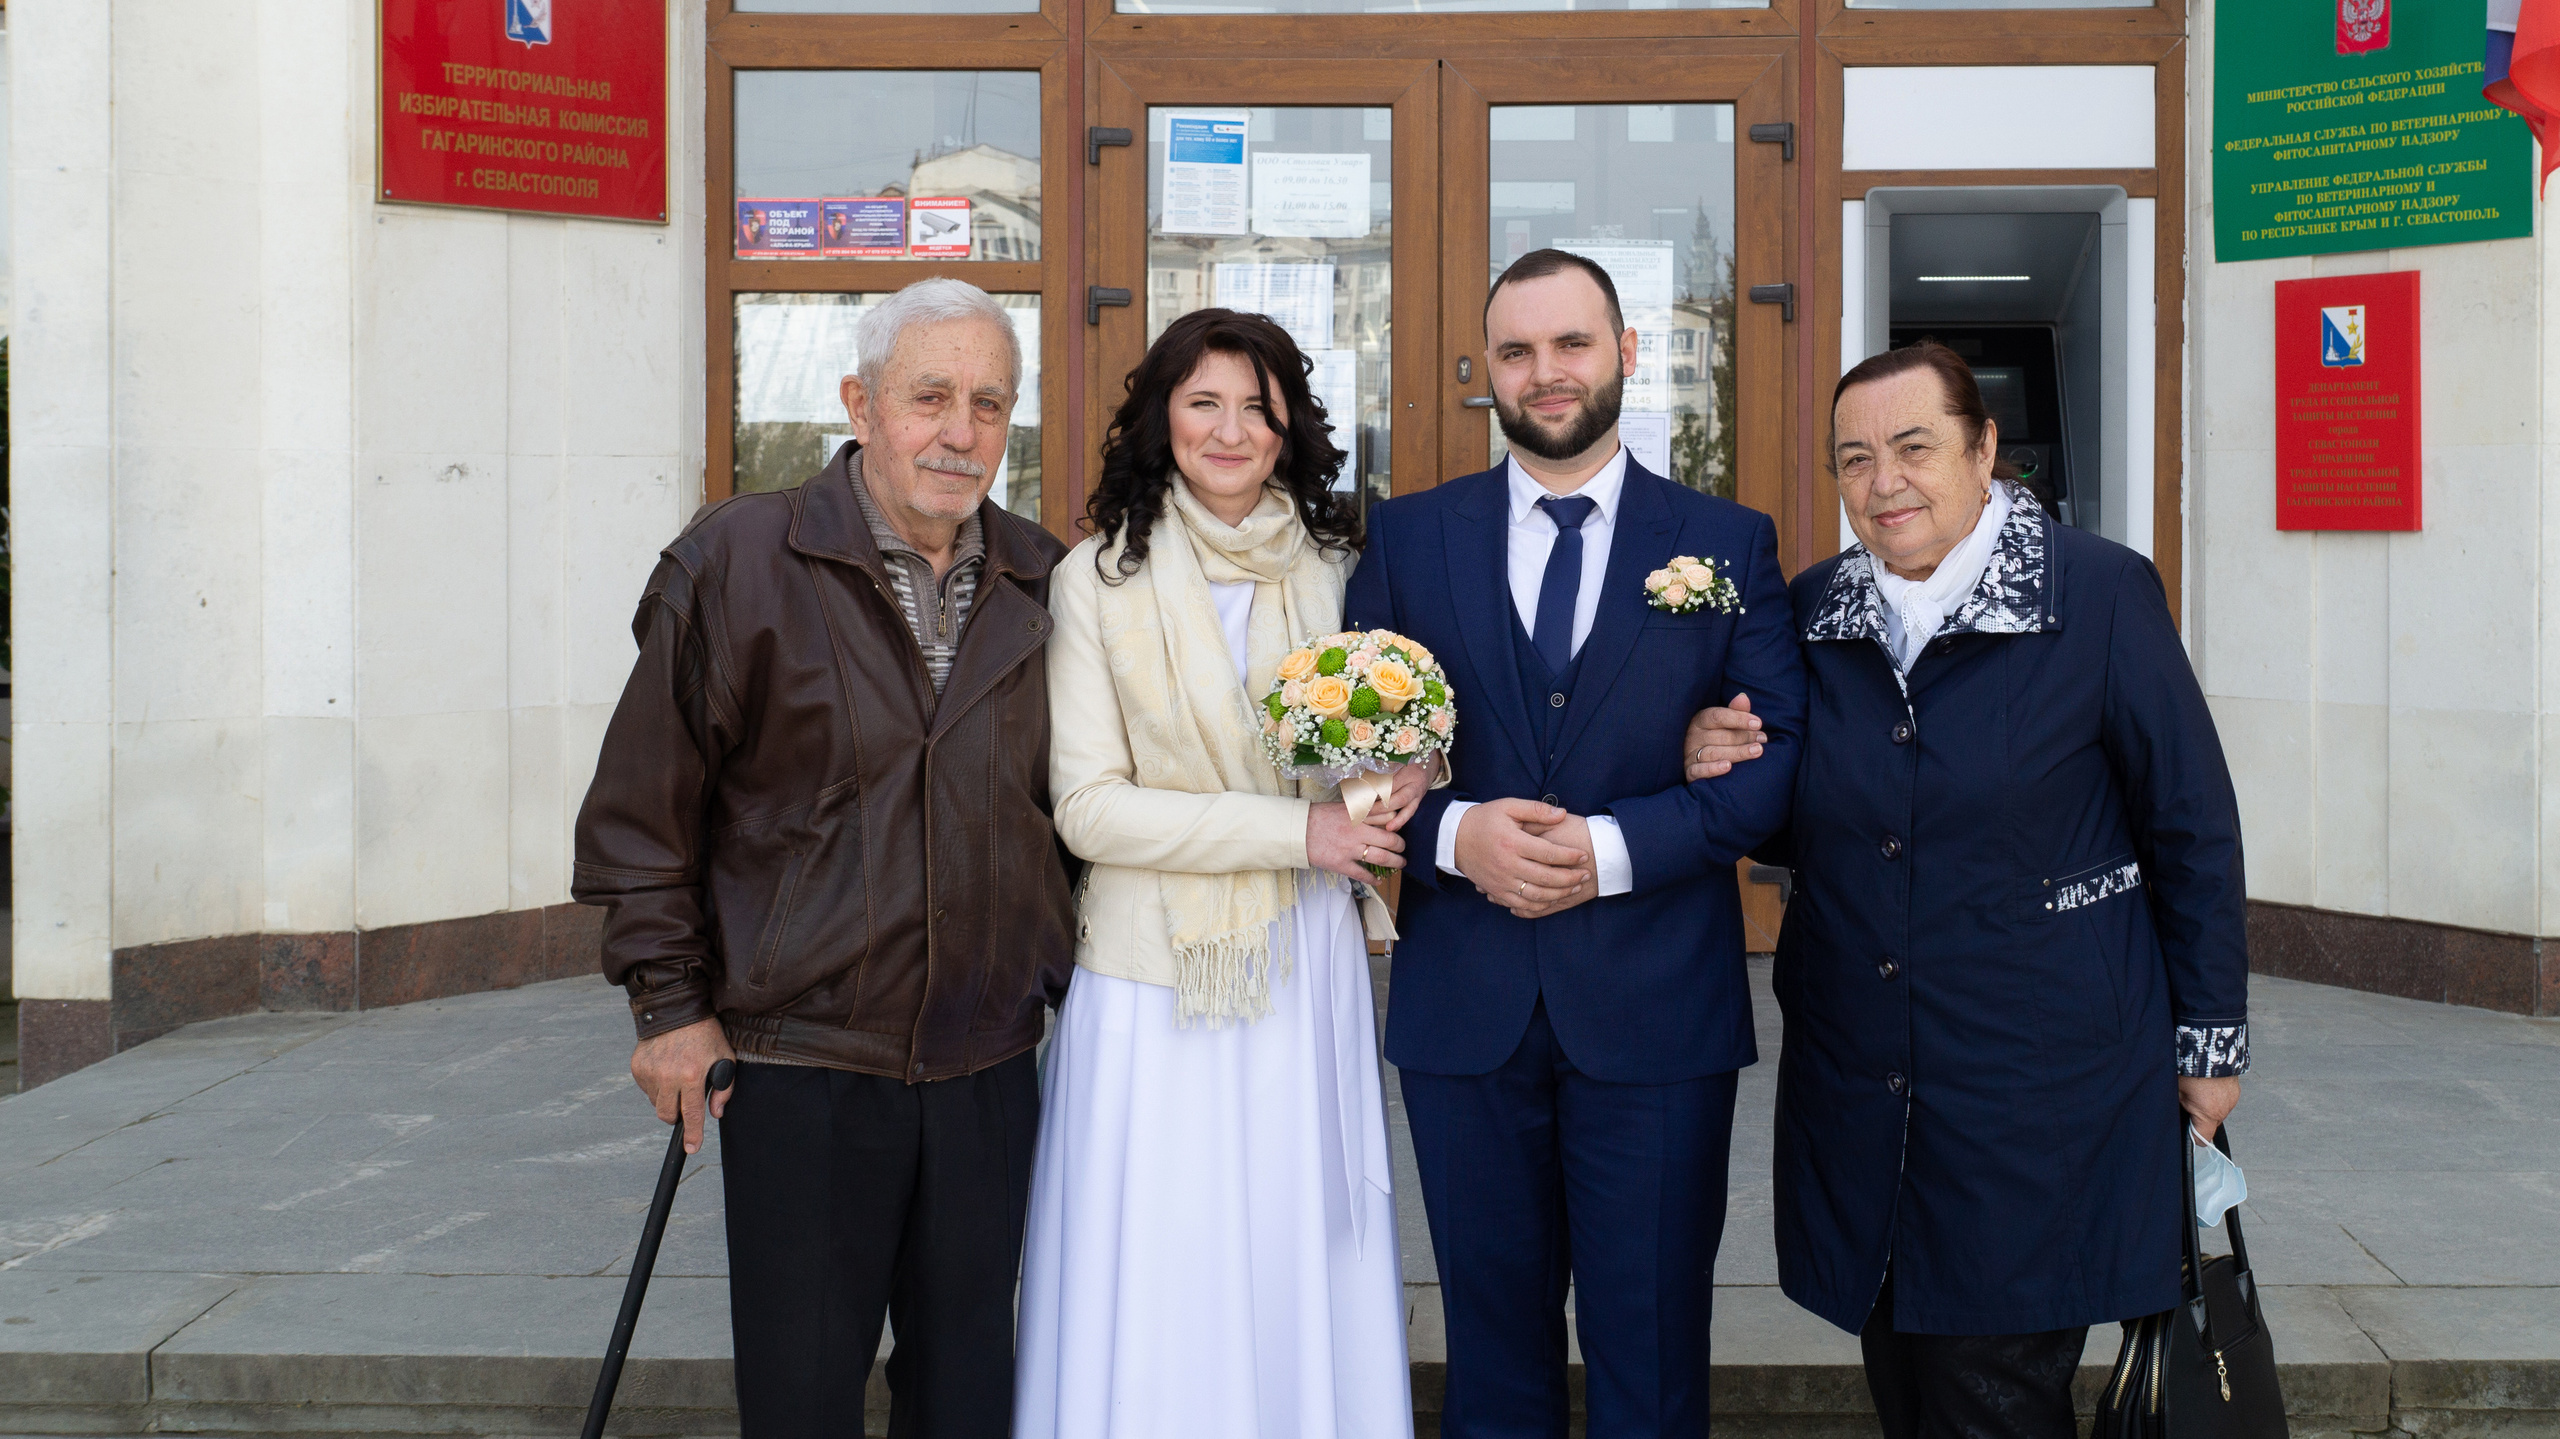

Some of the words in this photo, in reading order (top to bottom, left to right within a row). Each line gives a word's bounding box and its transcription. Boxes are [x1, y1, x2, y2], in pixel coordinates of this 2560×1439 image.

[442, 62, 611, 102] ТЕРРИТОРИАЛЬНАЯ
[2246, 81, 2338, 104] МИНИСТЕРСТВО
[2341, 71, 2411, 91] СЕЛЬСКОГО
[2414, 61, 2486, 81] ХОЗЯЙСТВ
[2286, 93, 2364, 114] РОССИЙСКОЙ
[2367, 83, 2446, 105] ФЕДЕРАЦИИ
[399, 92, 550, 127] ИЗБИРАТЕЛЬНАЯ
[559, 110, 649, 138] КОМИССИЯ
[2224, 131, 2310, 153] ФЕДЕРАЛЬНАЯ
[2313, 125, 2366, 143] СЛУЖБА
[2370, 122, 2388, 134] ПО
[2391, 108, 2504, 132] ВЕТЕРИНАРНОМУ
[421, 129, 558, 162] ГАГАРИНСКОГО
[562, 141, 630, 169] РАЙОНА
[2273, 137, 2397, 161] ФИТОСАНИТАРНОМУ
[2401, 129, 2461, 147] НАДЗОРУ
[1257, 157, 1279, 165] ООО
[456, 171, 468, 188] г.
[472, 168, 599, 199] СЕВАСТОПОЛЯ
[1282, 176, 1307, 184] 09.00
[2250, 175, 2330, 195] УПРАВЛЕНИЕ
[2333, 165, 2424, 186] ФЕДЕРАЛЬНОЙ
[2427, 159, 2488, 178] СЛУЖБЫ
[2296, 193, 2313, 205] ПО
[2316, 182, 2424, 204] ВЕТЕРИНАРНОМУ
[2426, 181, 2435, 192] И
[1281, 200, 1307, 210] 11.00
[2273, 200, 2397, 223] ФИТОСАНИТАРНОМУ
[2401, 195, 2461, 213] НАДЗОРУ
[769, 210, 808, 218] ОБЪЕКТ
[769, 219, 790, 227] ПОД
[2241, 230, 2258, 241] ПО
[2261, 224, 2338, 241] РЕСПУБЛИКЕ
[2341, 218, 2377, 233] КРЫМ
[2381, 217, 2390, 228] И
[2407, 208, 2500, 226] СЕВАСТОПОЛЬ
[769, 226, 815, 235] ОХРАНОЙ
[2308, 381, 2380, 393] ДЕПАРТАМЕНТ
[2290, 397, 2318, 407] ТРУДА
[2321, 397, 2328, 406] И
[2330, 393, 2400, 406] СОЦИАЛЬНОЙ
[2293, 411, 2335, 422] ЗАЩИТЫ
[2337, 409, 2397, 420] НАСЕЛЕНИЯ
[2328, 426, 2359, 436] города
[2308, 439, 2380, 449] СЕВАСТОПОЛЯ
[2312, 453, 2375, 463] УПРАВЛЕНИЕ
[2290, 468, 2319, 478] ТРУДА
[2321, 468, 2328, 477] И
[2330, 466, 2400, 478] СОЦИАЛЬНОЙ
[2293, 482, 2335, 492] ЗАЩИТЫ
[2337, 482, 2397, 491] НАСЕЛЕНИЯ
[2286, 497, 2361, 506] ГАГАРИНСКОГО
[2363, 495, 2403, 506] РАЙОНА
